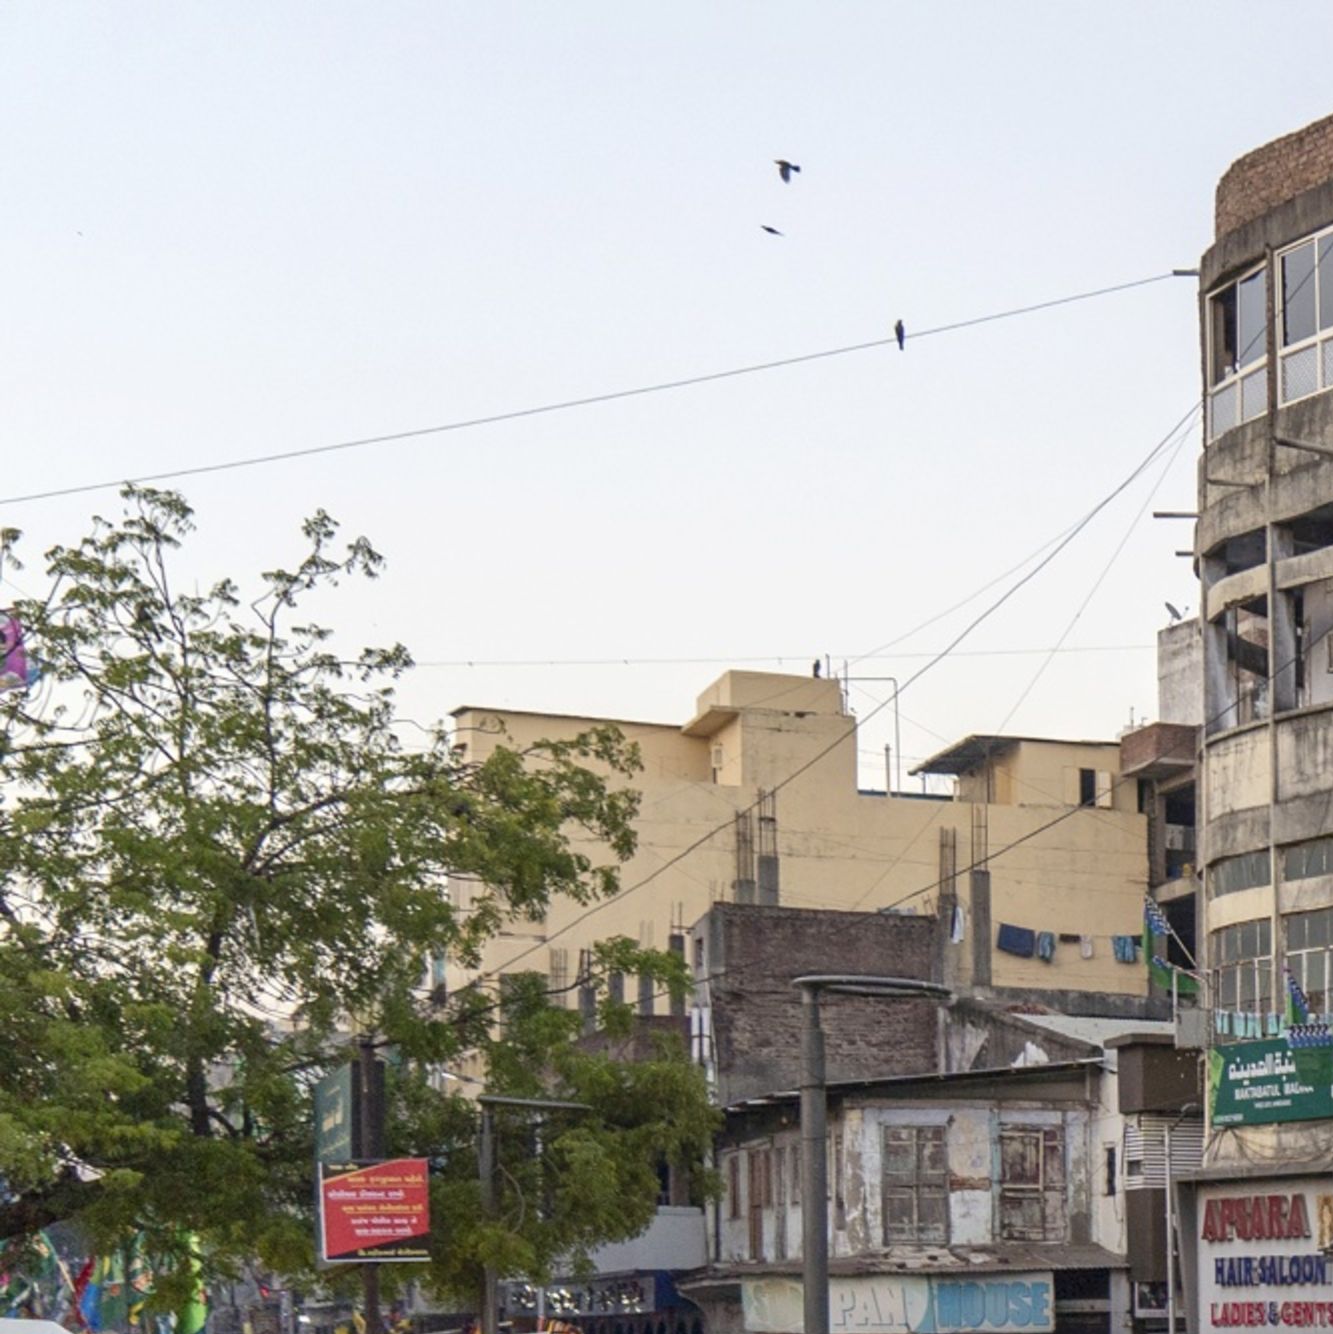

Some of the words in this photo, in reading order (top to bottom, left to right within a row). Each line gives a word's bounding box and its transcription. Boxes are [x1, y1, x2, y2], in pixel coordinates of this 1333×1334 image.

[1201, 1193, 1311, 1242] APSARA
[1214, 1256, 1251, 1288] HAIR
[1258, 1254, 1329, 1286] SALOON
[936, 1280, 1051, 1329] HOUSE
[1210, 1301, 1267, 1329] LADIES
